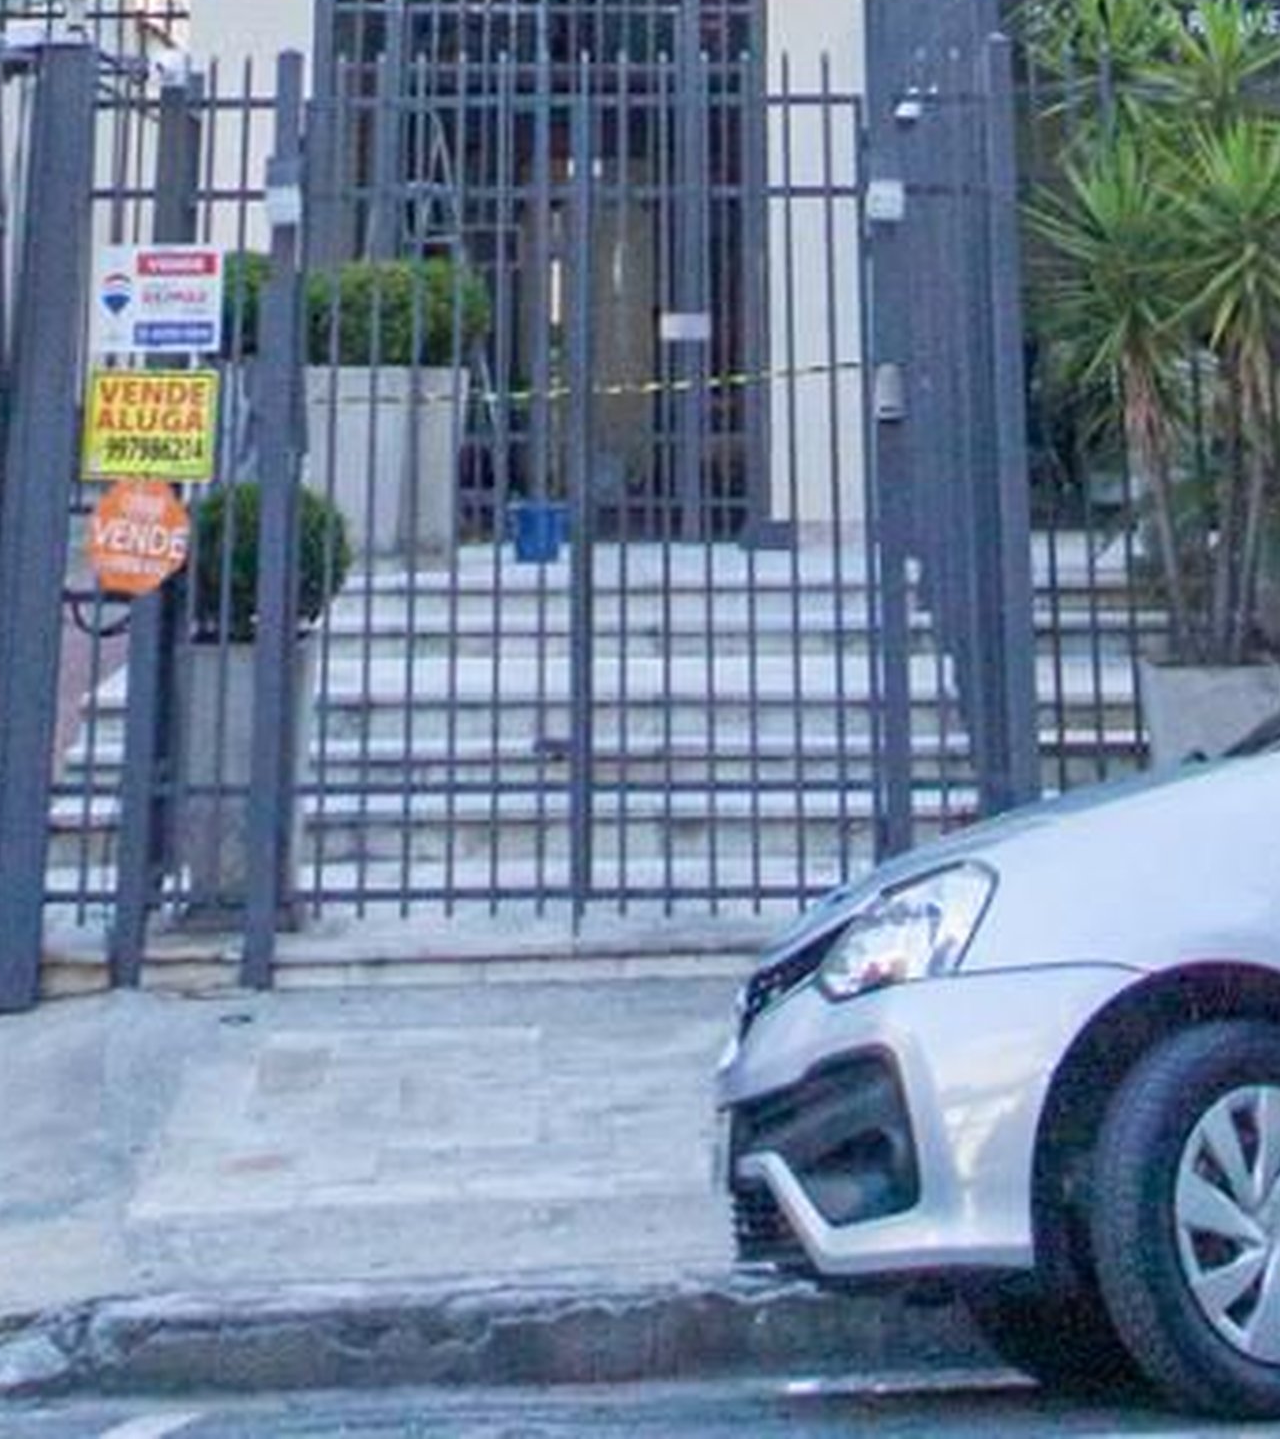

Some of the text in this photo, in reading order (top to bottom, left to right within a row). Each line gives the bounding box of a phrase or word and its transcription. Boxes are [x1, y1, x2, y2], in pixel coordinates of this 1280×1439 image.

[99, 380, 206, 406] VENDE
[97, 408, 204, 432] ALUGA
[95, 522, 188, 559] VENDE
